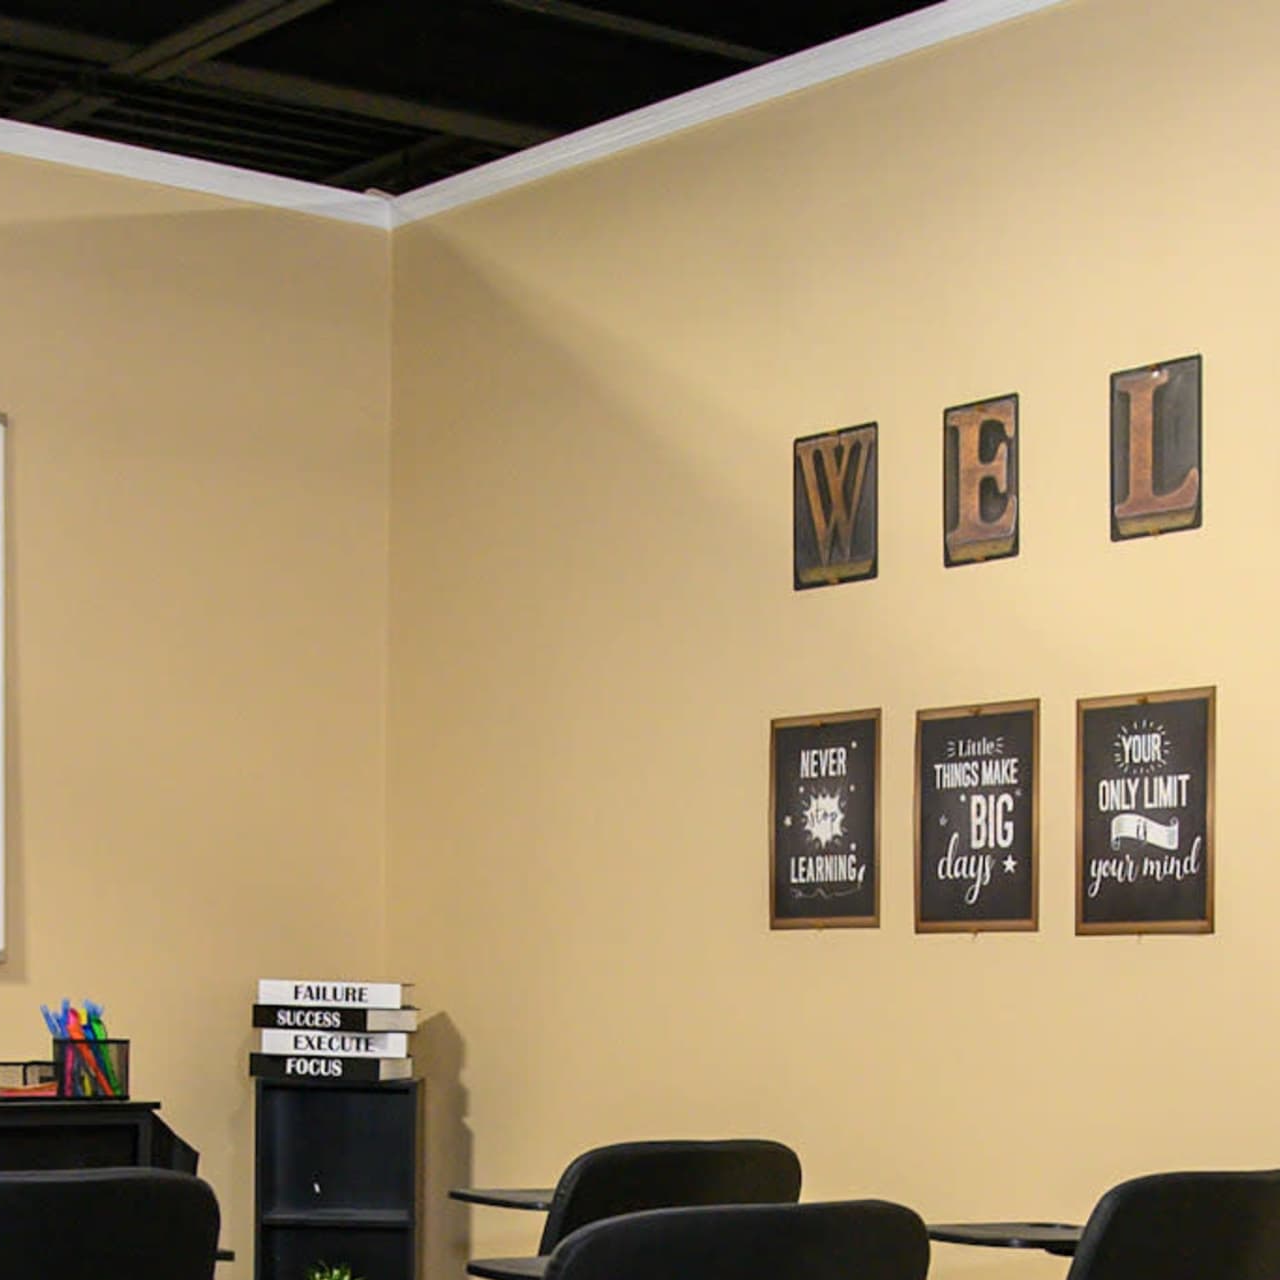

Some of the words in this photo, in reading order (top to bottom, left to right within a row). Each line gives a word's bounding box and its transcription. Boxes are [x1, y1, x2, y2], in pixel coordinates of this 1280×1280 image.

[800, 747, 847, 778] NEVER
[958, 737, 995, 757] Little
[1122, 733, 1162, 764] YOUR
[934, 761, 979, 789] THINGS
[981, 758, 1018, 786] MAKE
[1098, 777, 1140, 812] ONLY
[1144, 774, 1190, 809] LIMIT
[971, 793, 1014, 849] BIG
[790, 854, 857, 884] LEARNING
[937, 832, 996, 904] days
[1088, 854, 1138, 898] your
[1143, 836, 1201, 881] mind
[293, 984, 368, 1002] FAILURE
[276, 1009, 341, 1028] SUCCESS
[293, 1034, 376, 1052] EXECUTE
[285, 1058, 343, 1076] FOCUS
